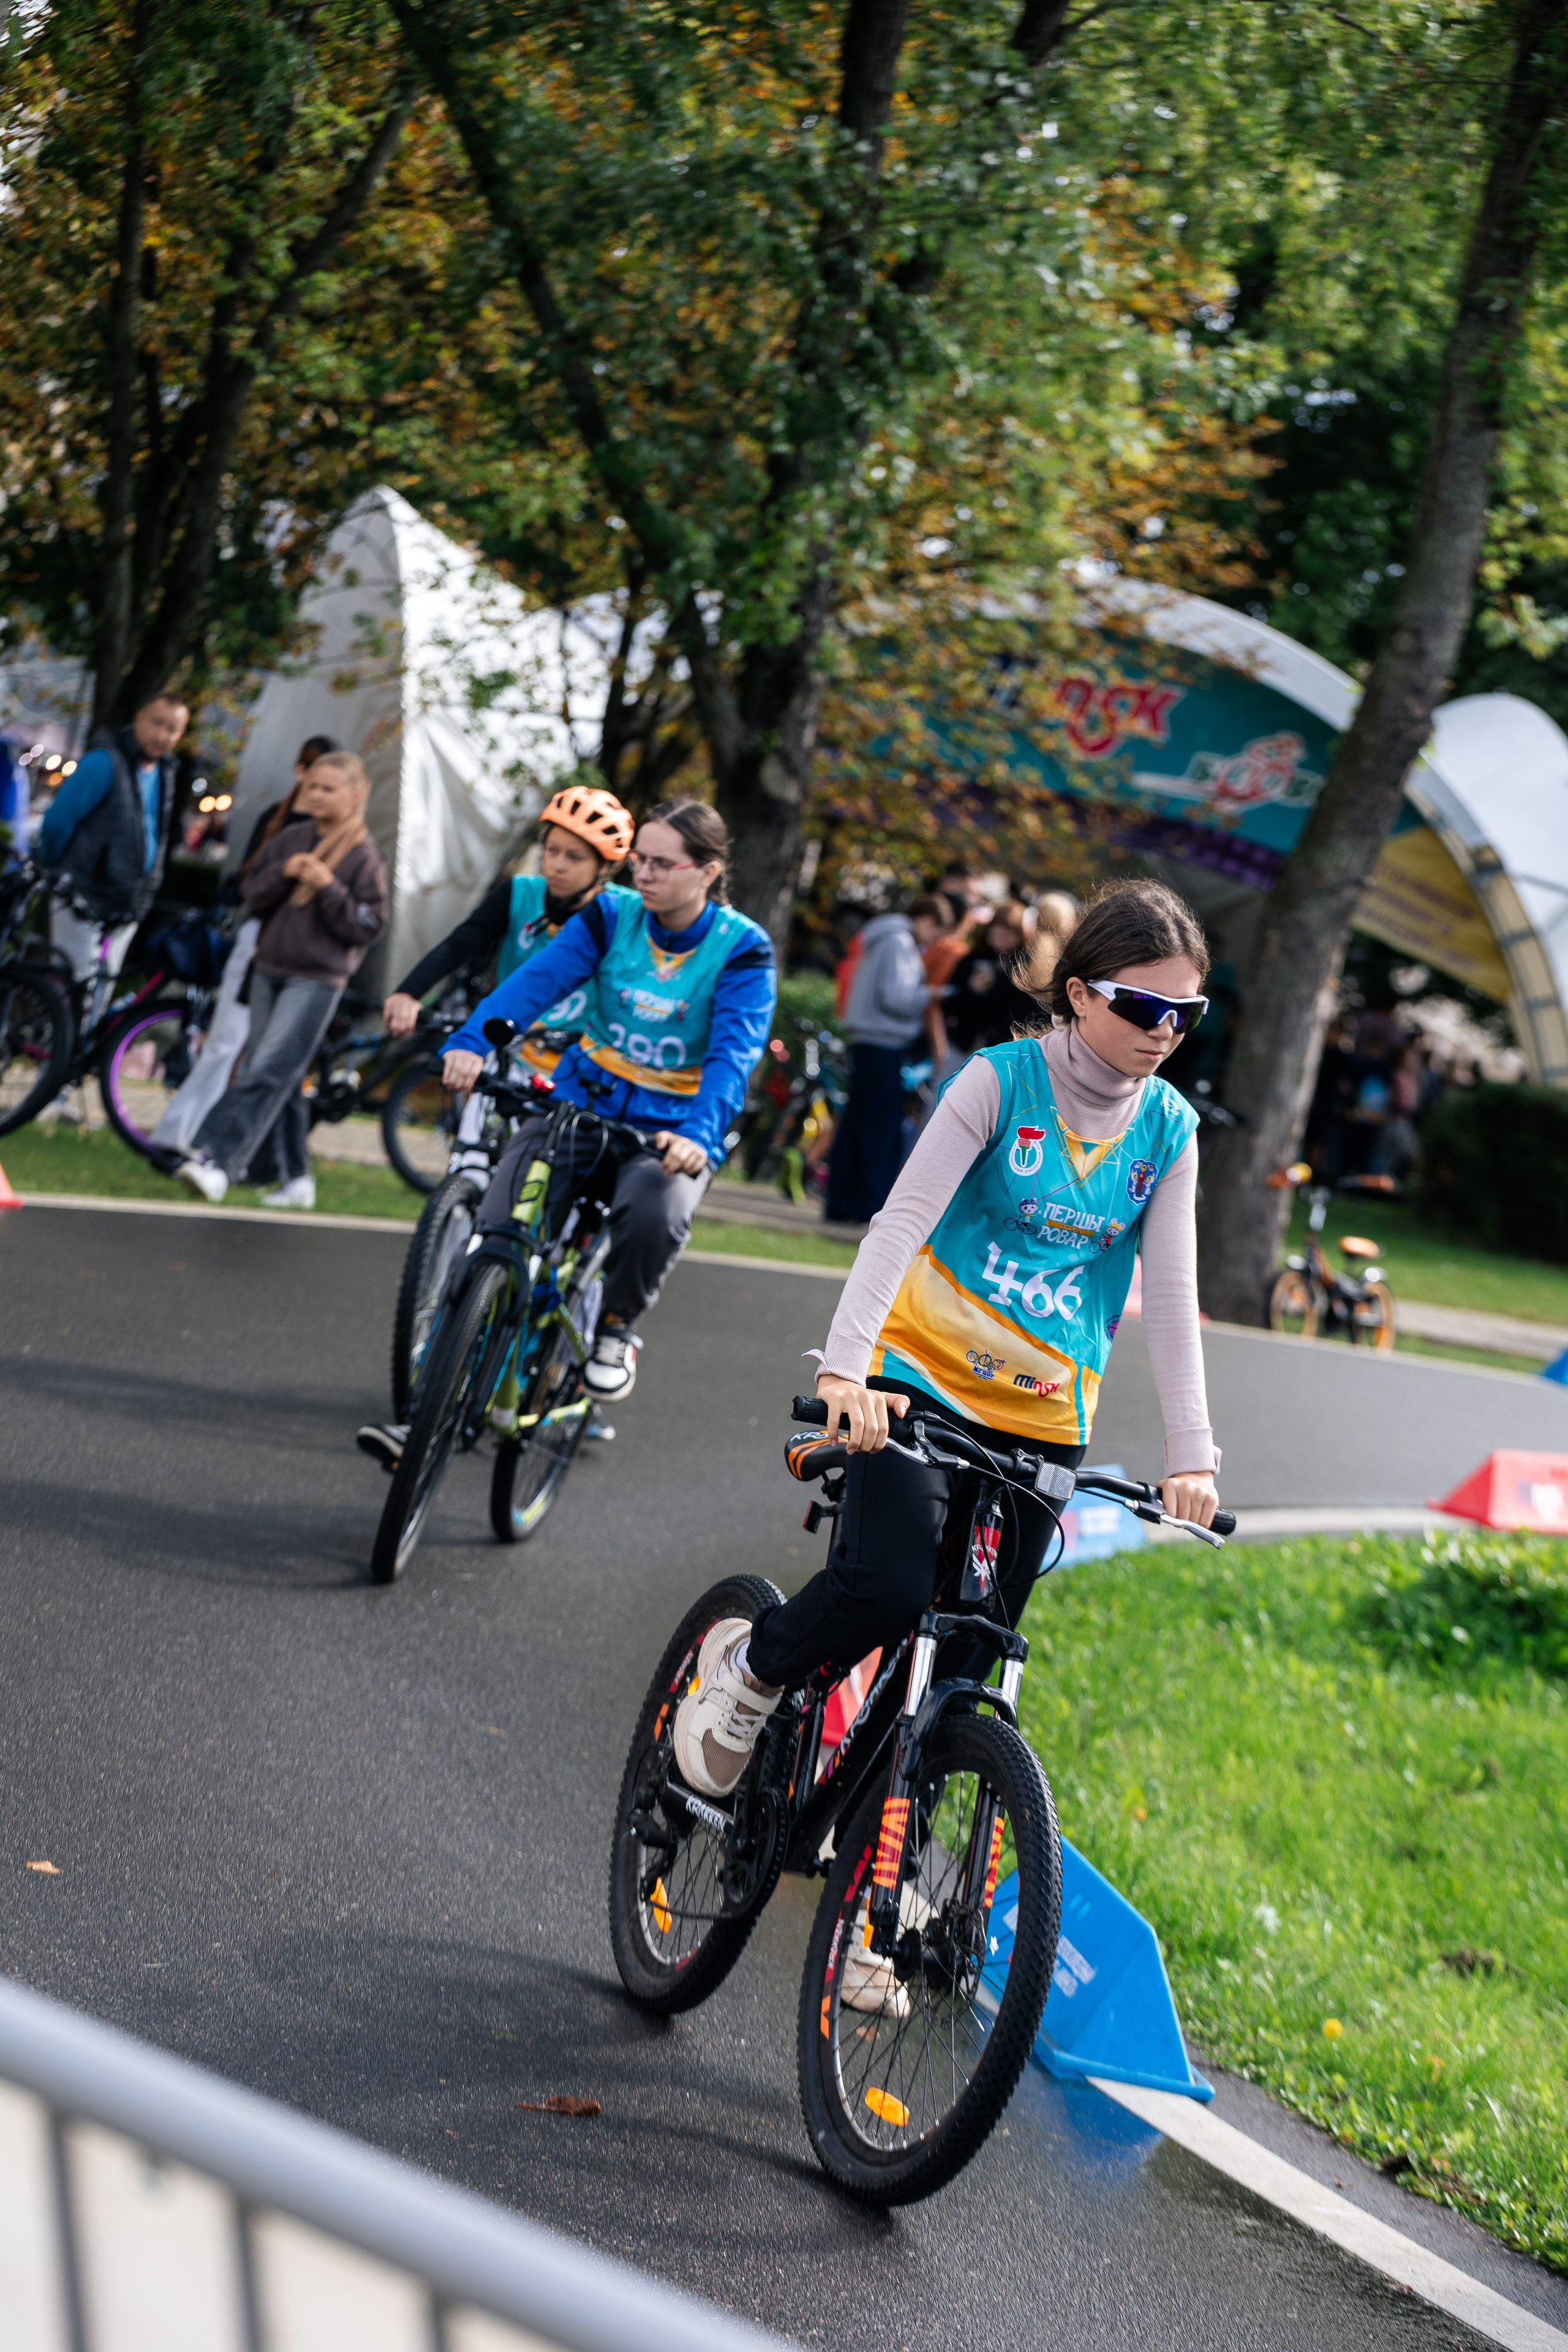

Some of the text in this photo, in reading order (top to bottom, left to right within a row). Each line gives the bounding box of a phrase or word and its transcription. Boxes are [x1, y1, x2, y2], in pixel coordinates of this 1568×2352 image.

[1042, 1202, 1106, 1232] ПЕРШЫ
[1036, 1226, 1088, 1249] РОВАР
[981, 1241, 1085, 1321] 466
[686, 1795, 727, 1833] KRAKKEN
